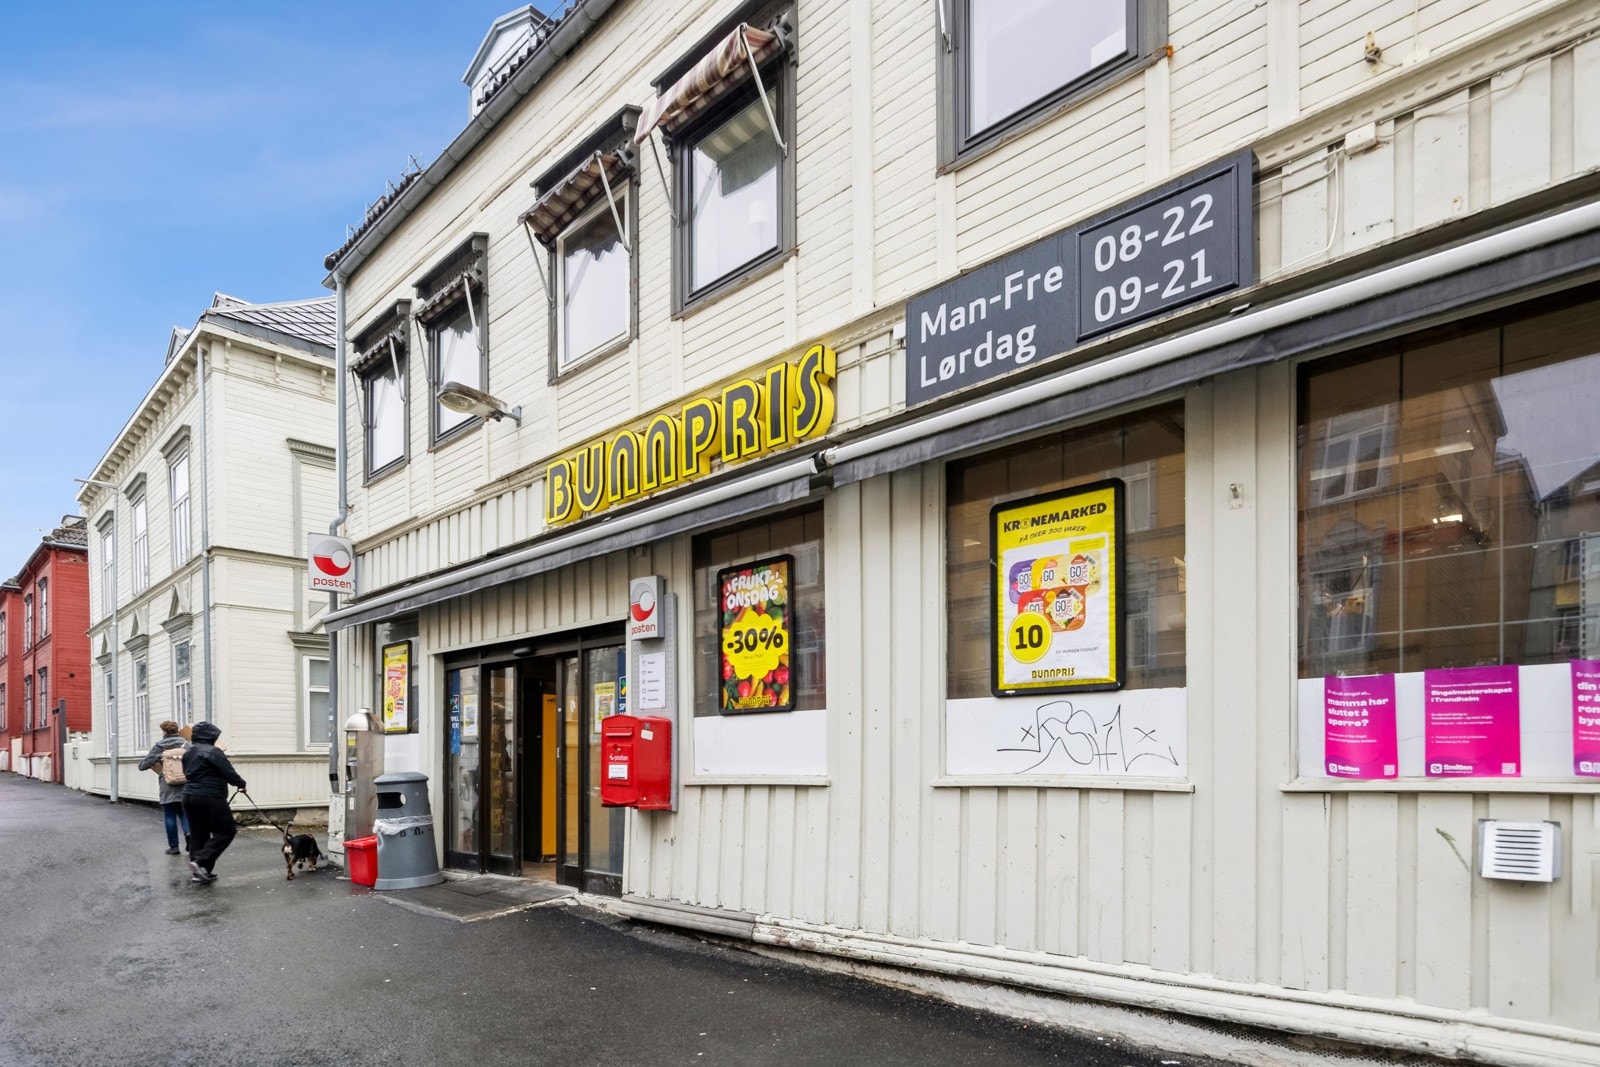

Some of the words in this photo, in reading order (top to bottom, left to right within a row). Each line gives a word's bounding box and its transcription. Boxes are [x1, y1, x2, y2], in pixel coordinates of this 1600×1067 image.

[920, 264, 1064, 344] Man-Fre
[1094, 193, 1214, 272] 08-22
[920, 324, 1037, 389] Lørdag
[1094, 248, 1213, 322] 09-21
[546, 344, 836, 526] BUNNPRIS
[1030, 530, 1047, 539] OVER
[1049, 527, 1062, 535] 300
[1064, 525, 1087, 533] VARER
[313, 577, 352, 589] posten
[727, 584, 779, 610] ONSDAG
[631, 623, 656, 635] posten
[727, 625, 784, 654] -30%
[1015, 624, 1043, 650] 10
[1031, 667, 1075, 679] BUNNPRIS
[1327, 698, 1368, 707] mamma
[1368, 698, 1389, 706] har
[1328, 708, 1359, 717] sluttet
[1328, 718, 1369, 727] sperre?
